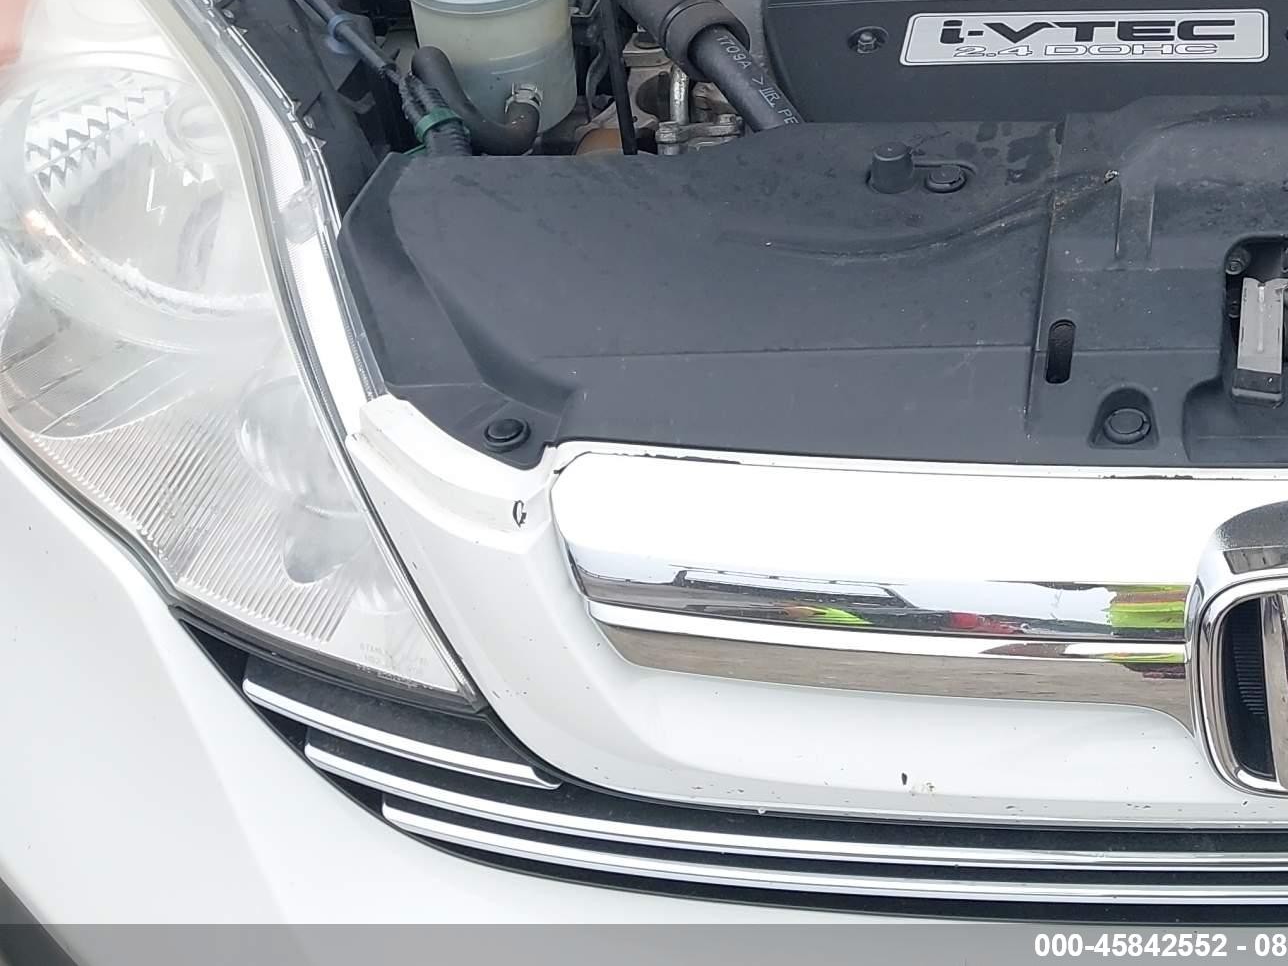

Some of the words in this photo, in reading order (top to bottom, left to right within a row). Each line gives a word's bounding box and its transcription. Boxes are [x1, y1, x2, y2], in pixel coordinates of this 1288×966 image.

[940, 19, 1236, 44] i-VTEC
[953, 45, 1033, 58] 2.4
[1044, 43, 1218, 56] DOHC
